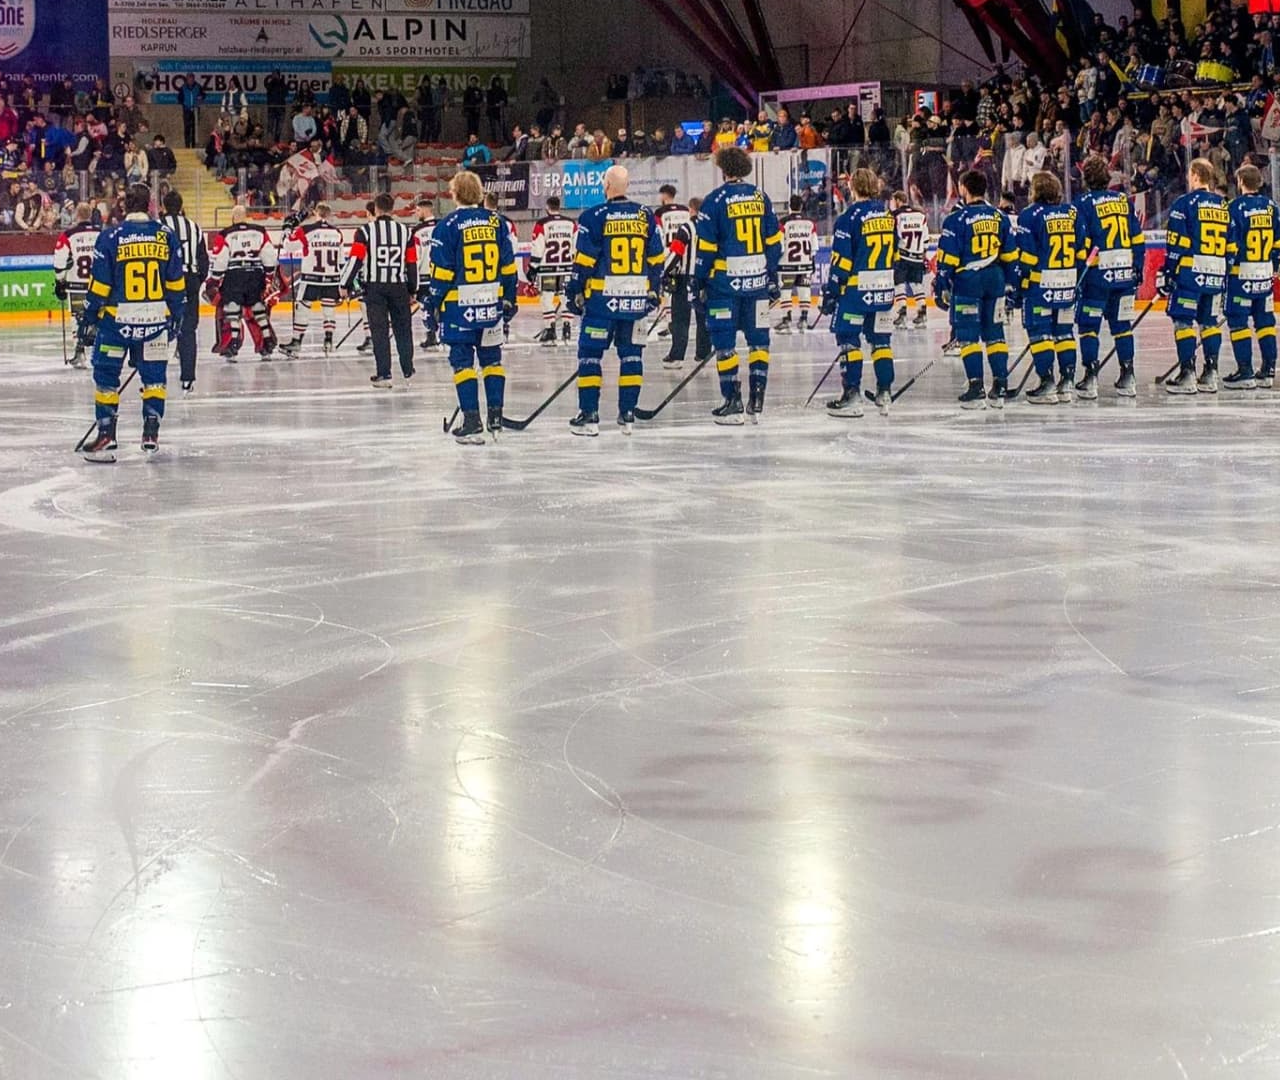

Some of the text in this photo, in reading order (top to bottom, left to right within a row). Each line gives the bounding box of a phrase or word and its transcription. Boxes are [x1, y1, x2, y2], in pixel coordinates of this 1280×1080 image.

[112, 25, 208, 39] RIEDLSPERGER
[353, 18, 466, 41] ALPIN
[140, 43, 178, 52] KAPRUN
[359, 46, 460, 56] DAS SPORTHOTEL
[484, 179, 526, 193] WARRIOR
[735, 217, 763, 254] 41
[901, 231, 923, 252] 77
[1101, 215, 1130, 249] 70
[1200, 222, 1228, 256] 55
[377, 246, 401, 267] 92
[545, 241, 572, 261] 22
[610, 237, 645, 275] 93
[788, 240, 812, 263] 24
[866, 233, 895, 269] 77
[1048, 234, 1076, 269] 25
[1246, 230, 1274, 262] 97
[313, 249, 338, 272] 14
[463, 242, 500, 283] 59
[124, 260, 164, 301] 60
